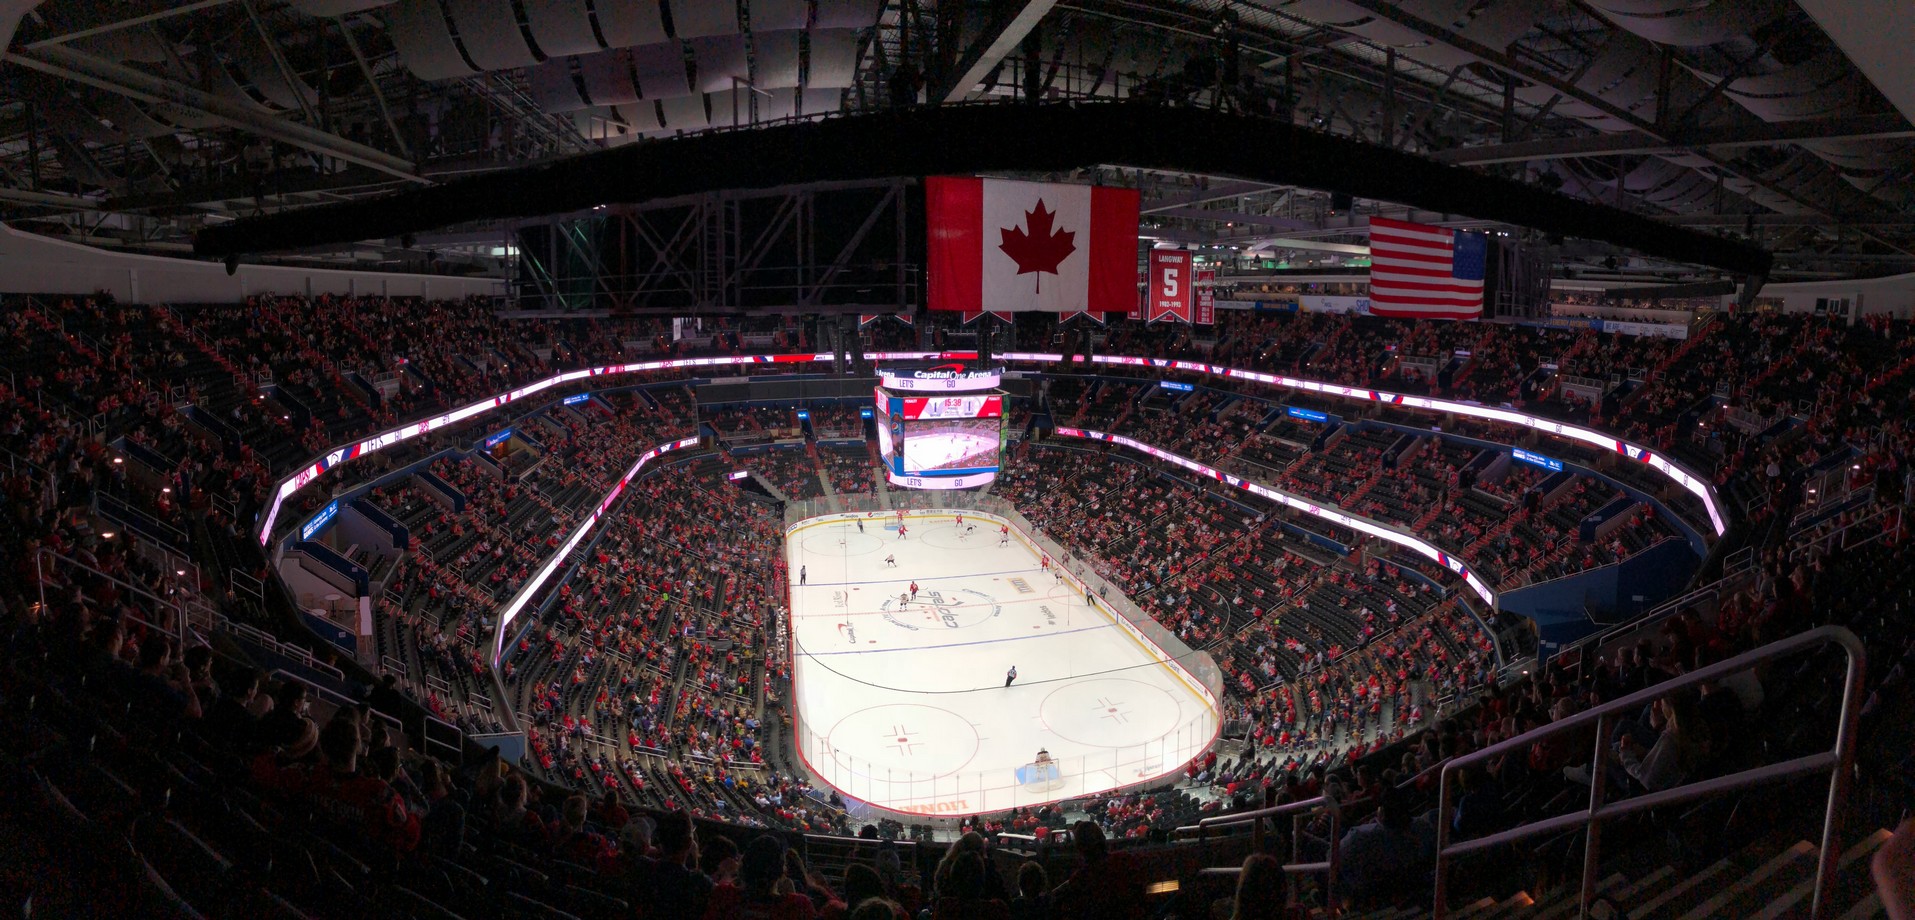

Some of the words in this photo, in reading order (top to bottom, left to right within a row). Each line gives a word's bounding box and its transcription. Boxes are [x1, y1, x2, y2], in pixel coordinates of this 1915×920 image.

[1159, 255, 1183, 263] LANGWAY
[1164, 268, 1178, 297] 5
[914, 370, 950, 380] Capital
[967, 371, 992, 380] Arena
[900, 380, 914, 388] LET'S
[946, 380, 956, 388] GO
[907, 478, 922, 487] LET'S
[955, 479, 963, 487] GO
